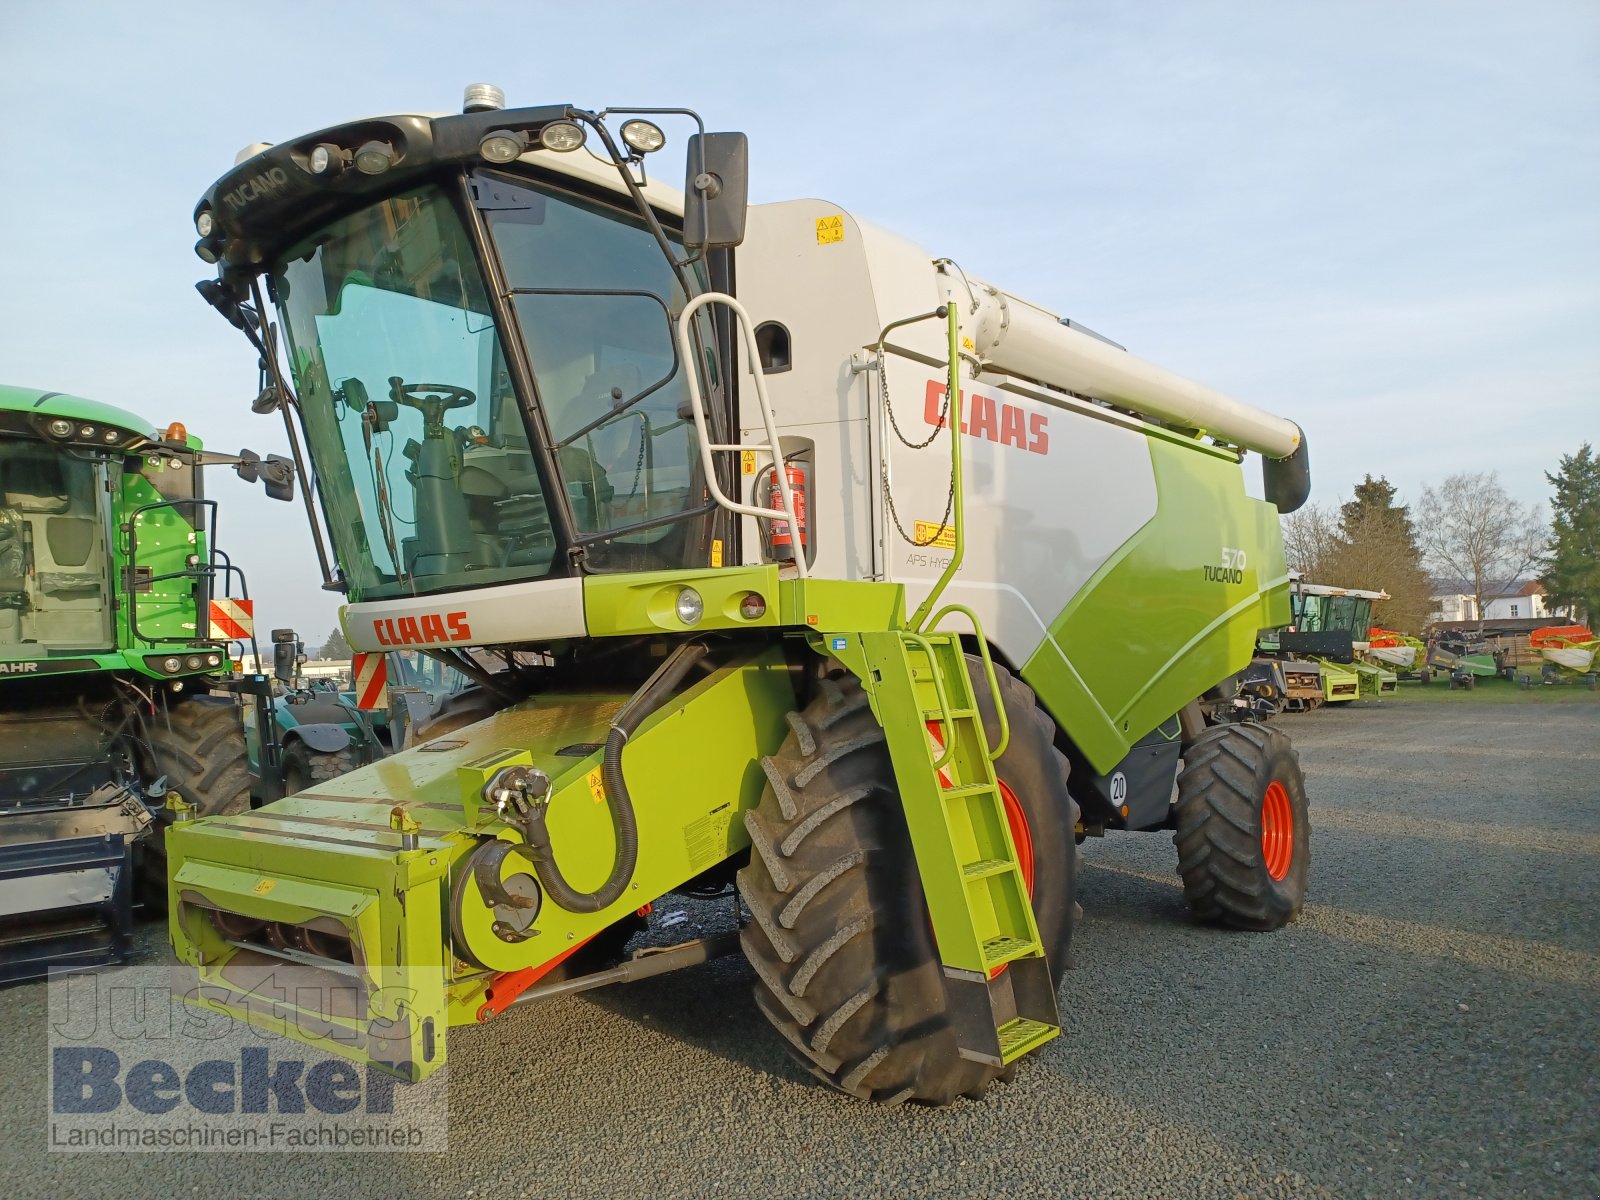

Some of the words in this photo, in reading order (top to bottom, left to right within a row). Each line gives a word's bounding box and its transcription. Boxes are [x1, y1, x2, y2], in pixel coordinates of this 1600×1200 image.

[223, 167, 288, 211] TUCANO
[924, 379, 1049, 456] CLAAS
[906, 553, 927, 567] APS
[1221, 547, 1247, 571] 570
[1203, 565, 1243, 584] TUCANO
[373, 611, 472, 645] CLAAS
[1113, 777, 1124, 800] 20
